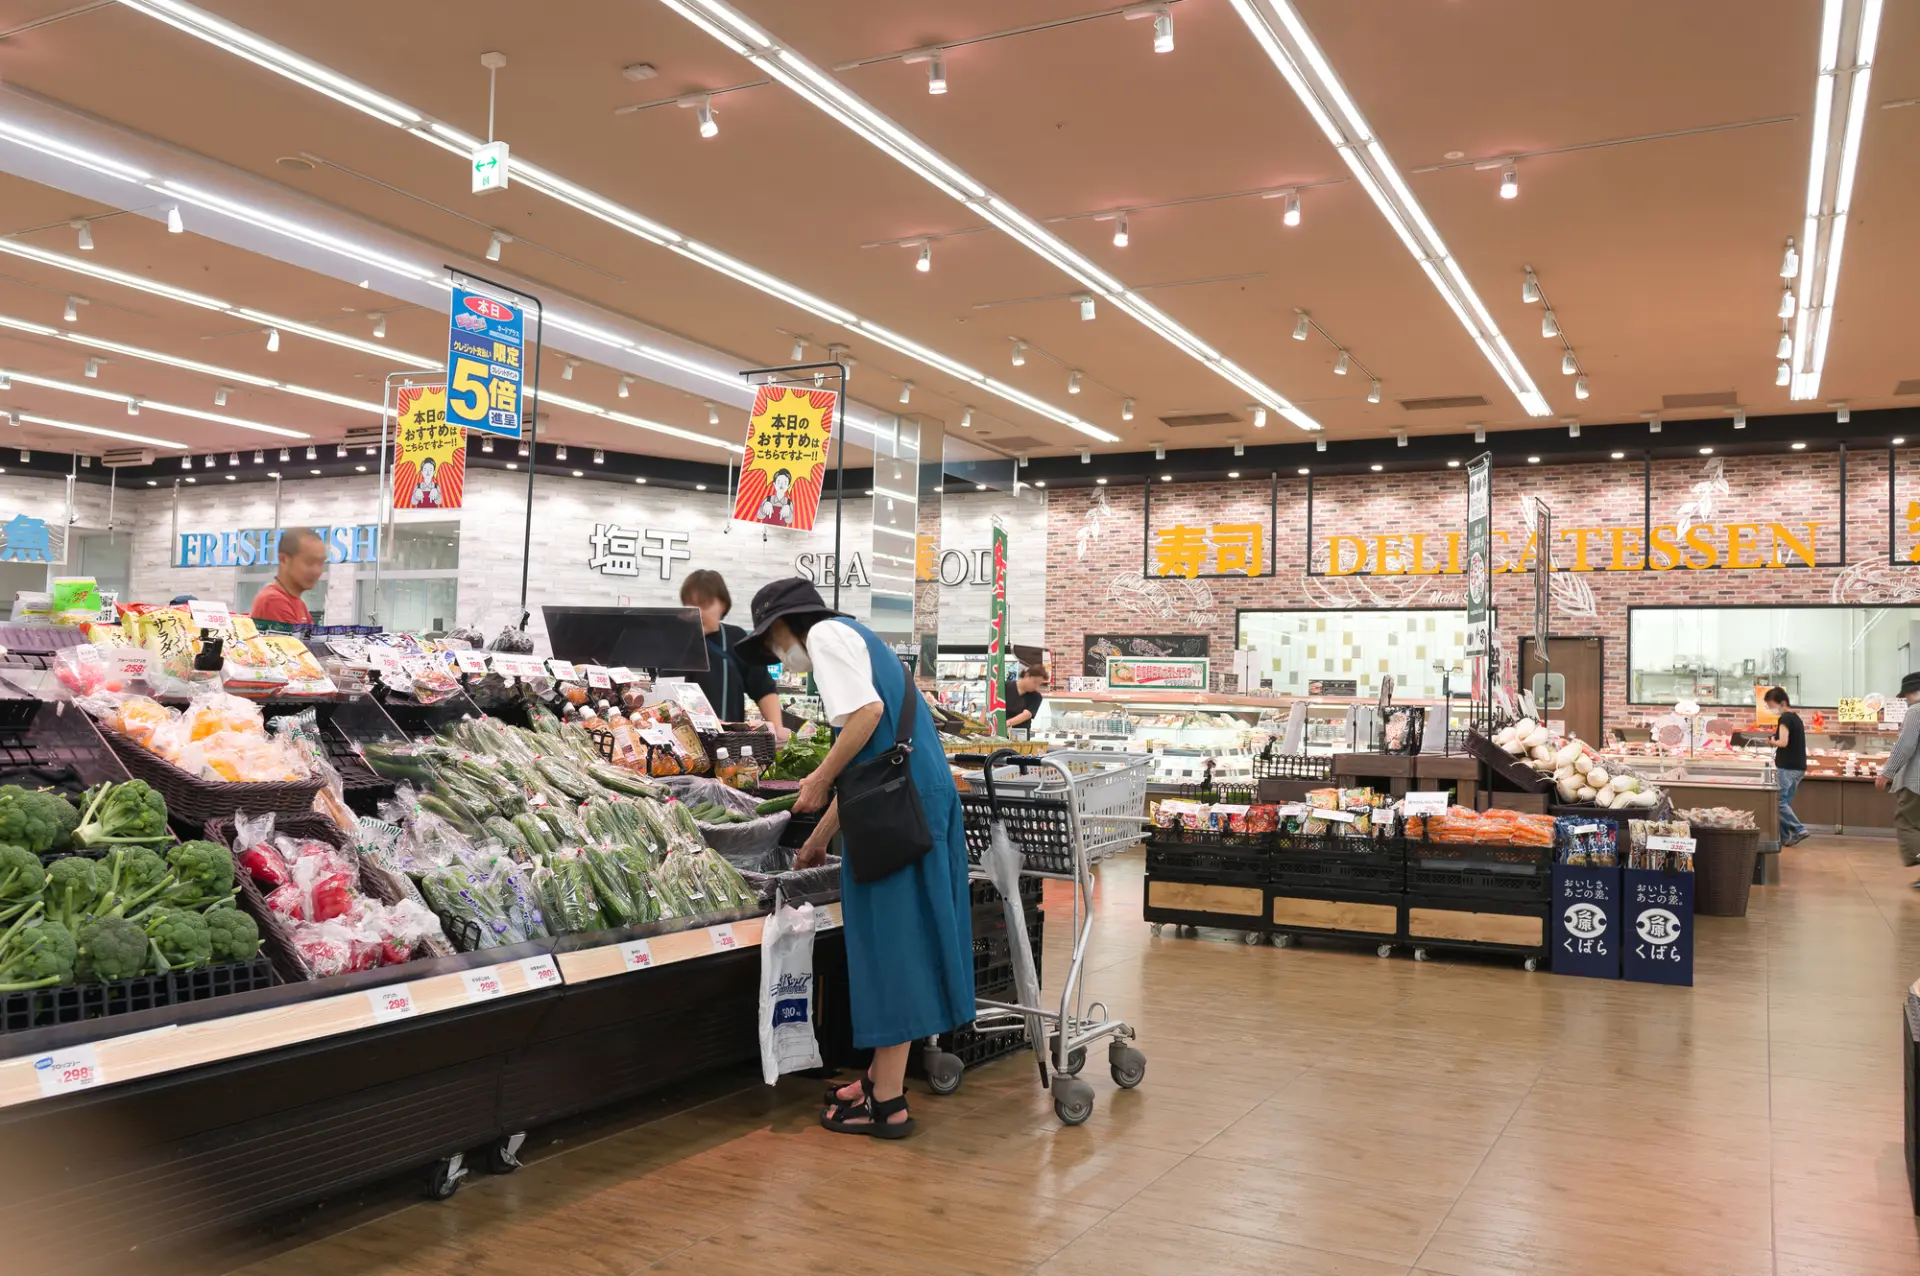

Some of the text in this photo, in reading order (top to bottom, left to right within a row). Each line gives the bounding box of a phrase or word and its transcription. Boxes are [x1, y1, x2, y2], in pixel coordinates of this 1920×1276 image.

[477, 299, 500, 318] 本日
[493, 342, 520, 367] 限定
[449, 357, 517, 421] 5 倍
[413, 409, 446, 425] 本日の
[491, 412, 516, 427] 進呈
[771, 413, 810, 430] 本日の
[405, 424, 458, 441] おすすめは
[757, 432, 820, 448] おすすめは
[0, 513, 54, 563] 魚
[180, 530, 286, 567] FRESH
[588, 523, 692, 581] 塩干
[1156, 523, 1264, 580] 寿司
[795, 551, 871, 588] SEA
[153, 618, 173, 656] サラダ
[123, 664, 143, 673] 258
[1564, 879, 1609, 891] おいしさ、
[1637, 884, 1683, 896] おいしさ、
[1564, 888, 1609, 901] あごの差。
[1637, 893, 1683, 906] あごの差。
[1563, 938, 1608, 956] くばら
[1636, 944, 1682, 962] くばら
[480, 981, 496, 992] 298
[388, 998, 406, 1010] 298
[51, 1060, 81, 1071] ブロッコリー
[63, 1067, 89, 1083] 298
